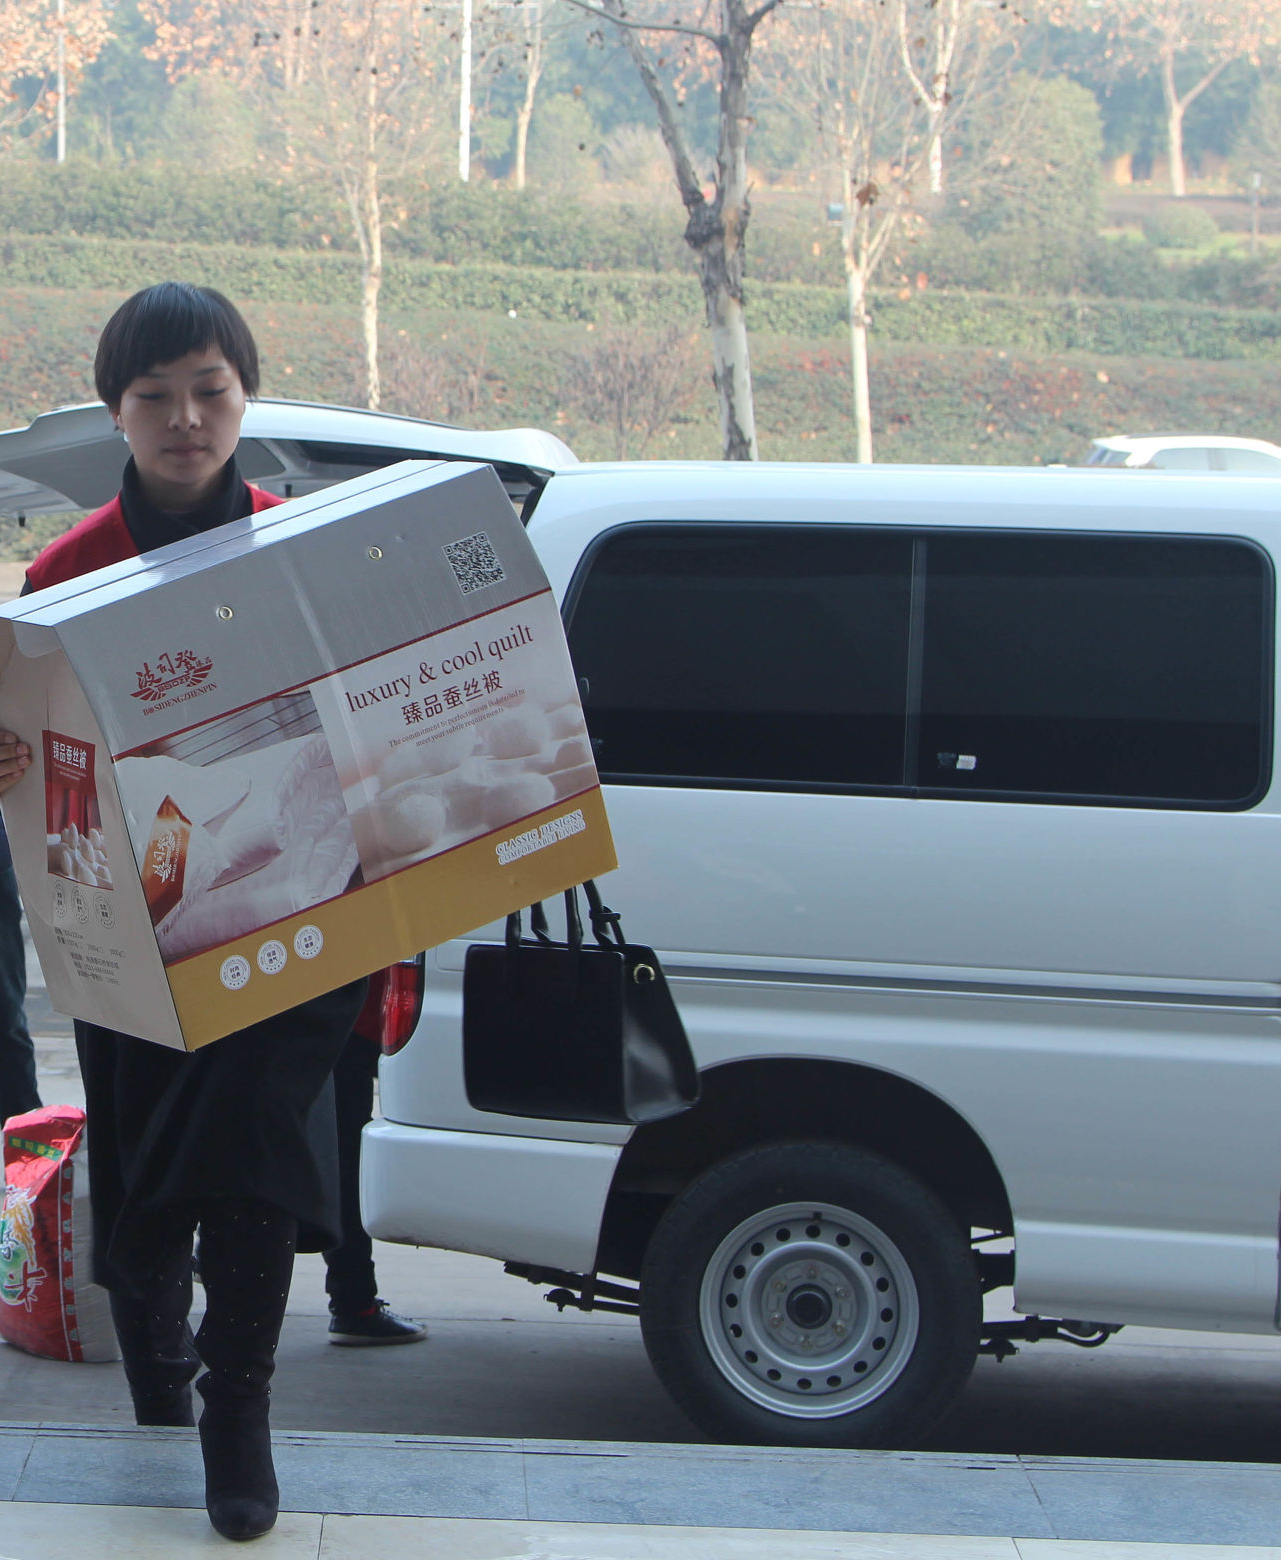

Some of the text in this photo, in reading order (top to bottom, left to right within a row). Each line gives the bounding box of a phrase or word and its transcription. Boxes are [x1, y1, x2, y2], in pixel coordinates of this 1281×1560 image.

[344, 624, 534, 713] luxury & cool quilt
[400, 670, 504, 725] 臻品蚕丝被
[496, 810, 583, 855] CLASSIC DESIGNS
[499, 834, 557, 865] COMFORTABLE
